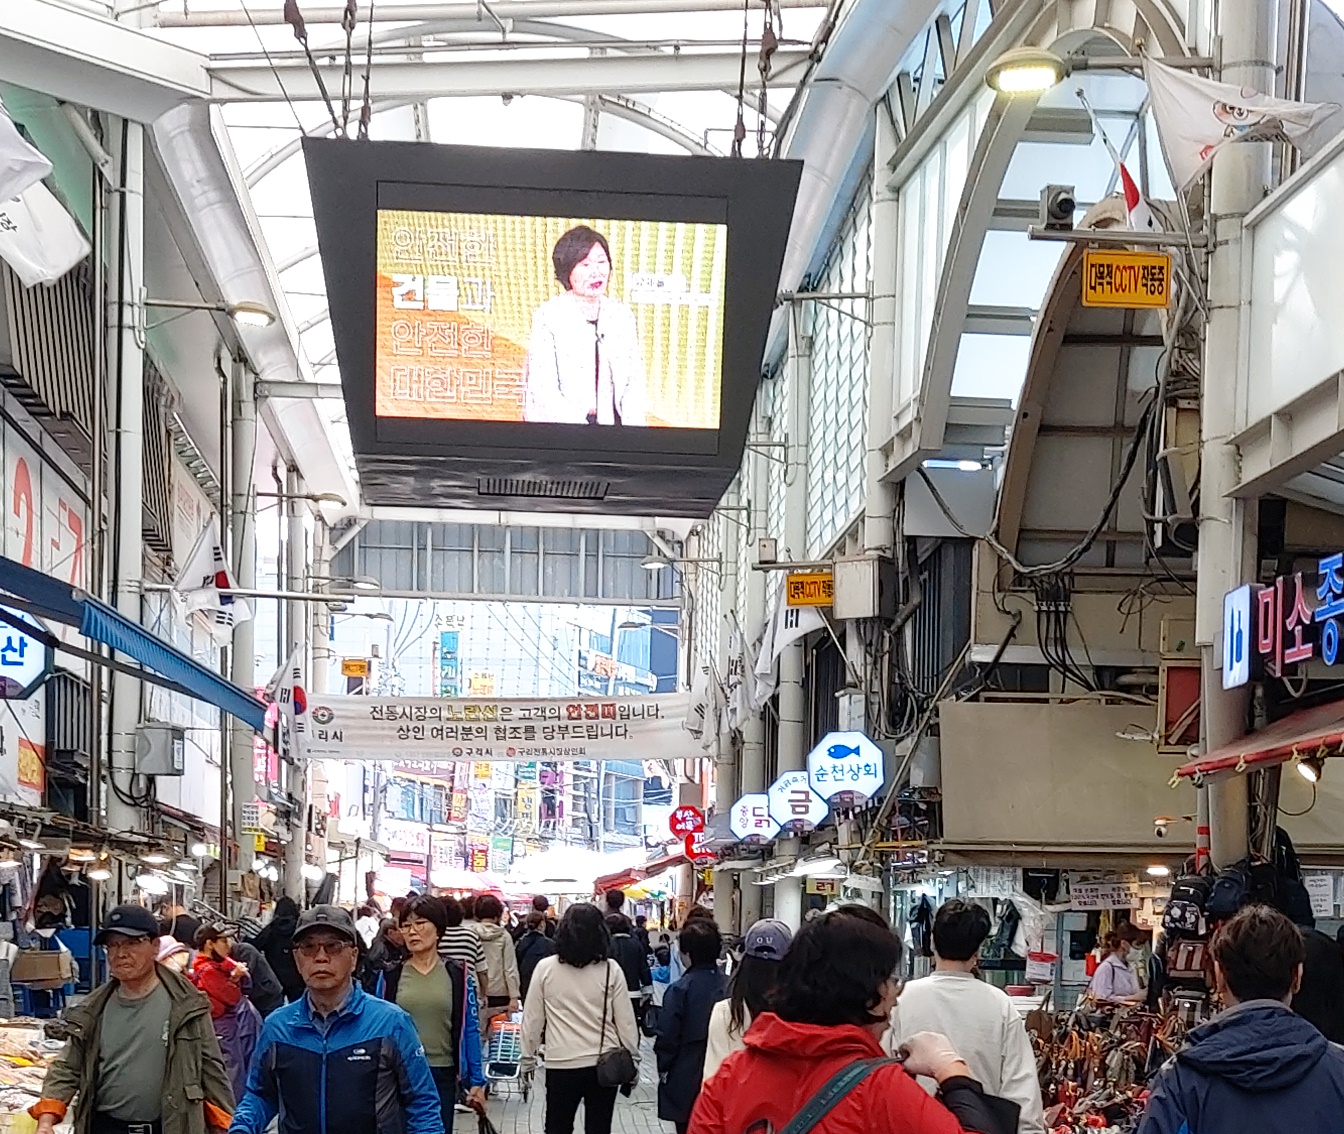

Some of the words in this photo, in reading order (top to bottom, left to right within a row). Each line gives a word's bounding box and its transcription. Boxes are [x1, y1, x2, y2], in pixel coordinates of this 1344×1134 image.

[390, 319, 493, 359] 안전한
[370, 704, 444, 722] 전통시장의
[446, 704, 513, 723] 노란선은
[518, 705, 562, 722] 고객의
[396, 725, 426, 741] 상인
[430, 725, 488, 742] 여러분의
[494, 725, 537, 742] 협조를
[541, 724, 635, 741] 당부드립니다.
[814, 762, 878, 783] 순천상회
